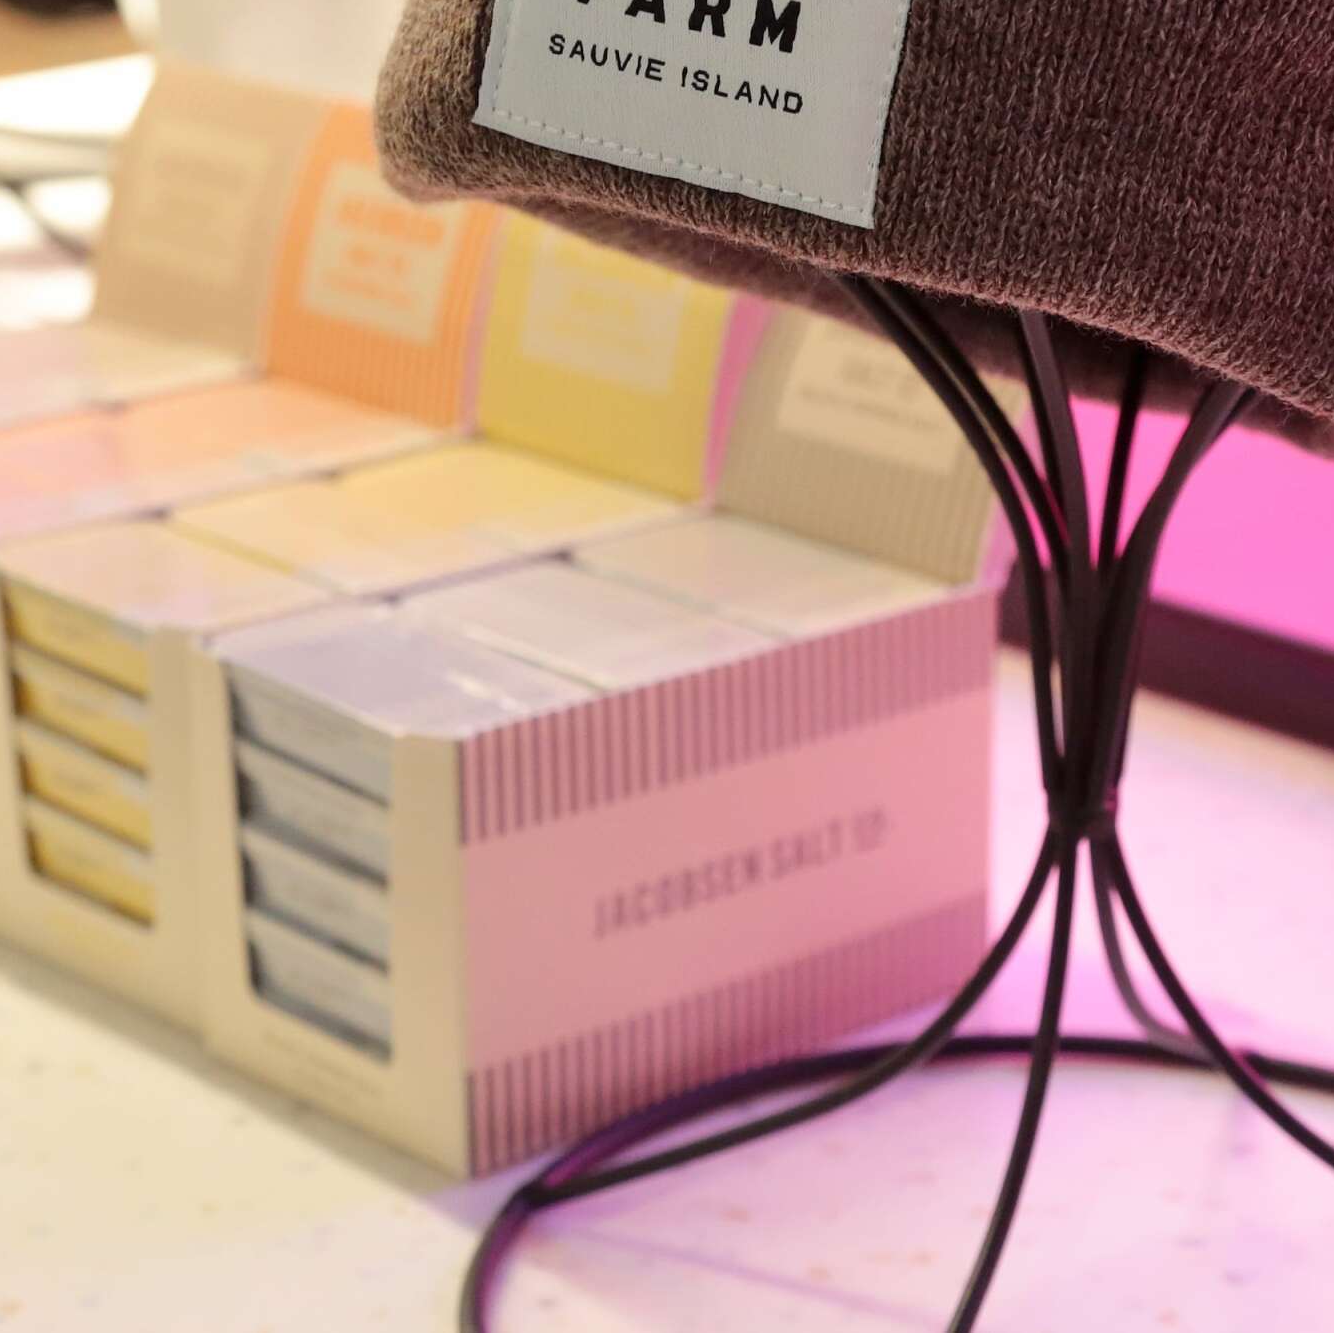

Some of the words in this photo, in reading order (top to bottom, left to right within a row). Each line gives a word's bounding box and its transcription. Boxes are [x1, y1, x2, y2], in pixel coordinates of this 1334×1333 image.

[548, 33, 666, 82] SAUVIE
[680, 65, 804, 115] ISLAND
[592, 847, 764, 940] JACOBSEN
[770, 815, 843, 880] SALT
